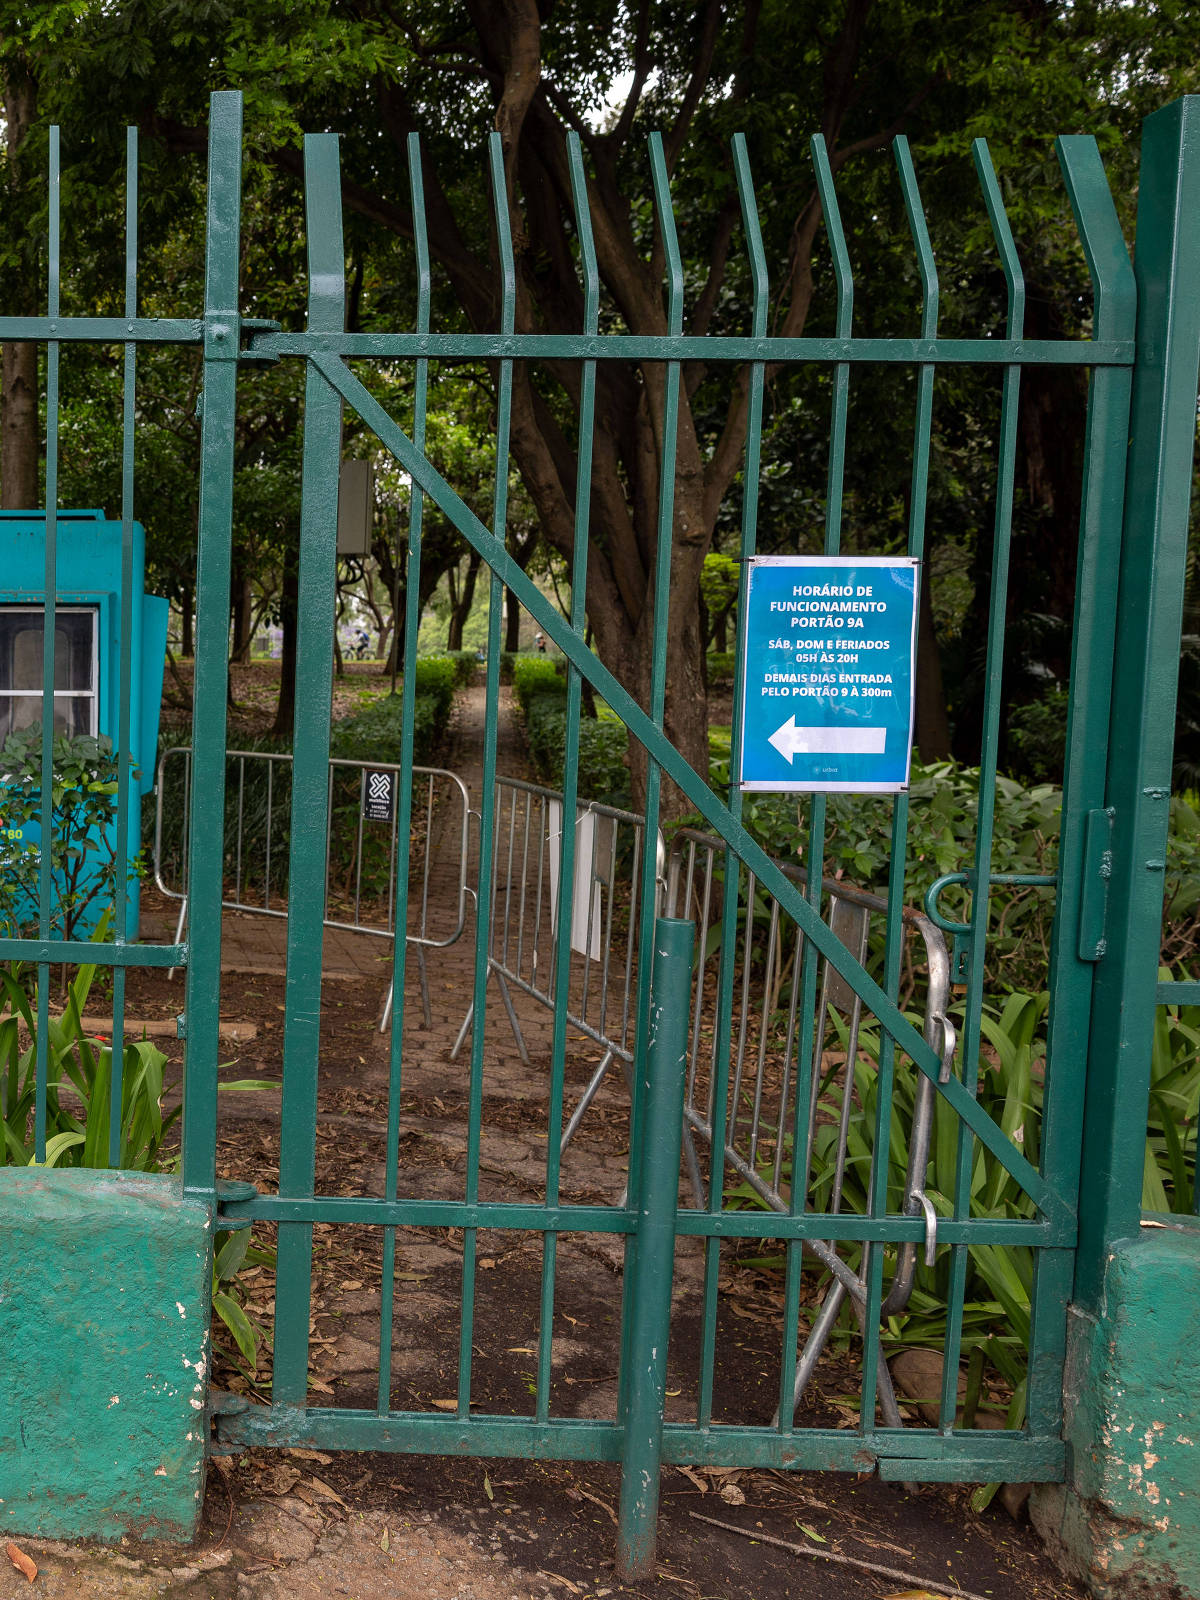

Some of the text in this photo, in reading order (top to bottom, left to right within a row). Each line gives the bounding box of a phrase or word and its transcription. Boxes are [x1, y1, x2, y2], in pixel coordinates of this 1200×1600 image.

[792, 583, 873, 596] HORÁRIO DE
[770, 601, 887, 613] FUNCIONAMENTO
[791, 615, 864, 628] PORTÃO 9A
[768, 638, 890, 650] SÁB, DOM E FERIADOS
[796, 651, 859, 663] 05H ÀS 20H
[764, 673, 893, 684] DEMAIS DIAS ENTRADA
[761, 685, 892, 697] PELO PORTÃO 9 À 300m
